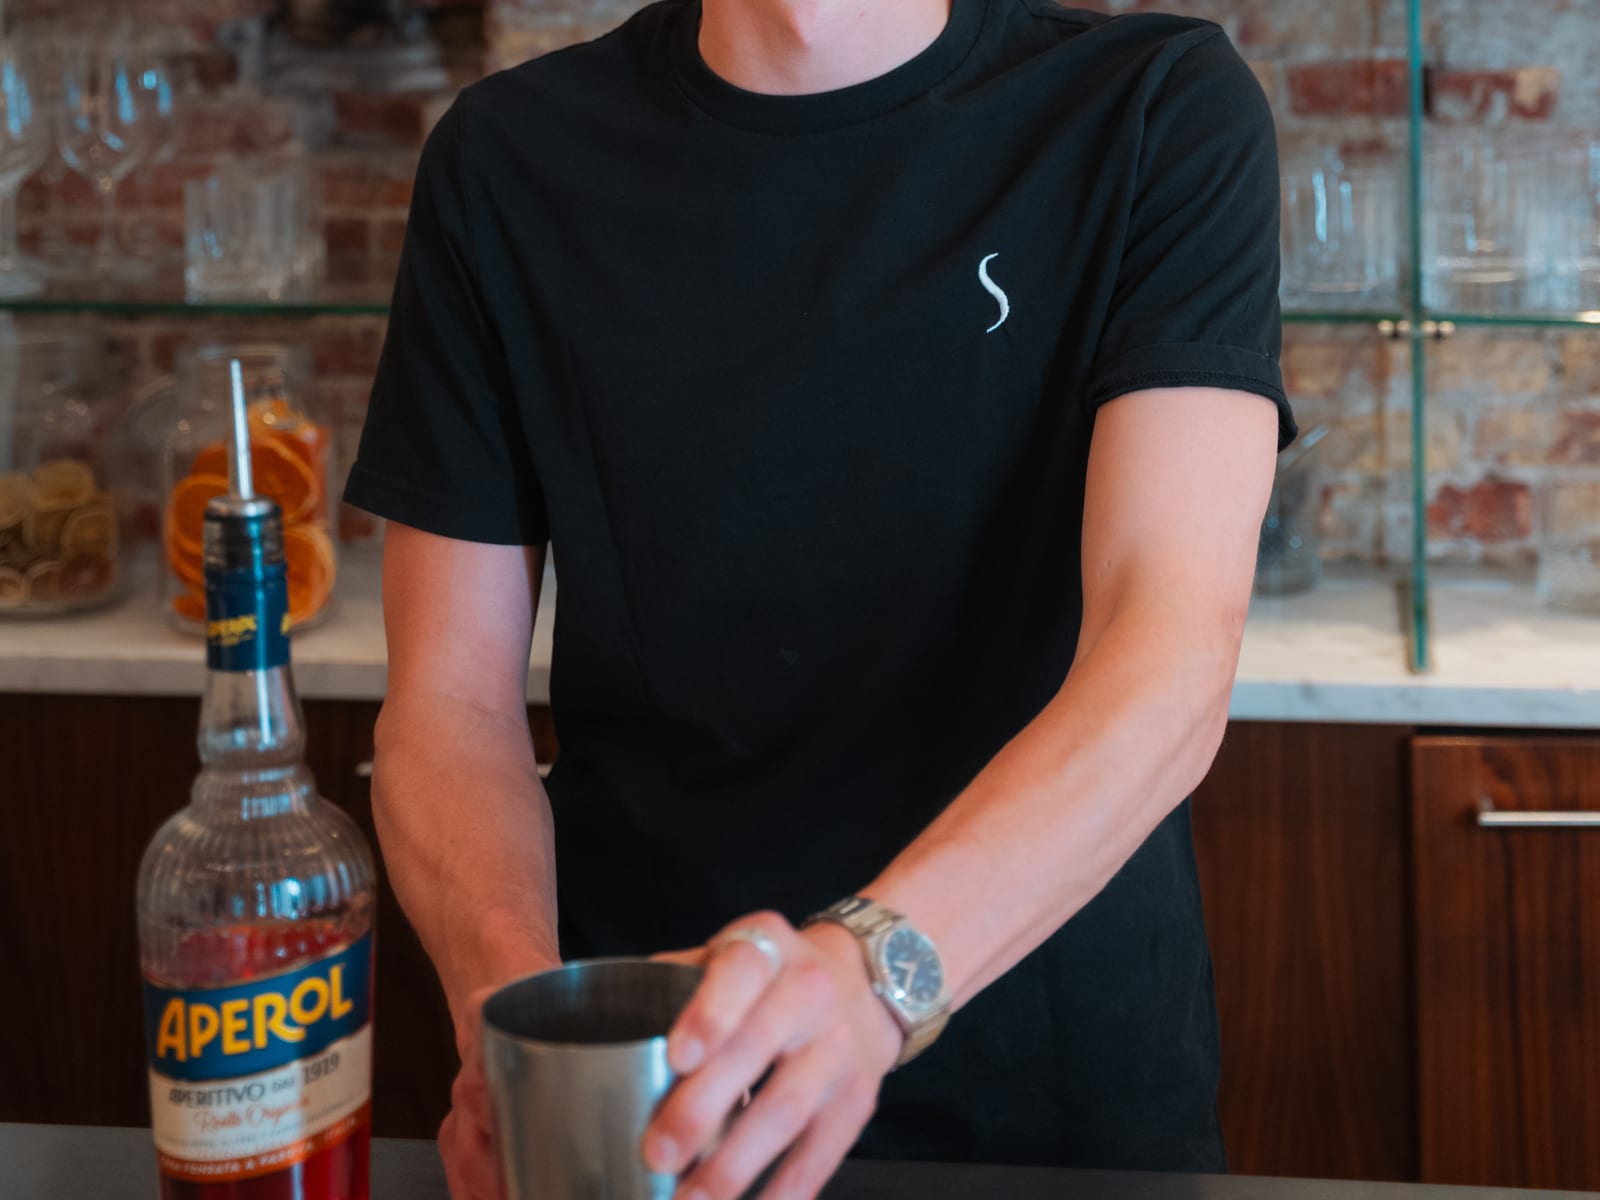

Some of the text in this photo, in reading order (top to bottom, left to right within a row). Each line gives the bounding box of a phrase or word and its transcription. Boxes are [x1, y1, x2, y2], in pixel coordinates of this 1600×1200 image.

[156, 964, 353, 1062] APEROL
[168, 1081, 265, 1109] APERITIVO
[303, 1052, 340, 1085] 1919
